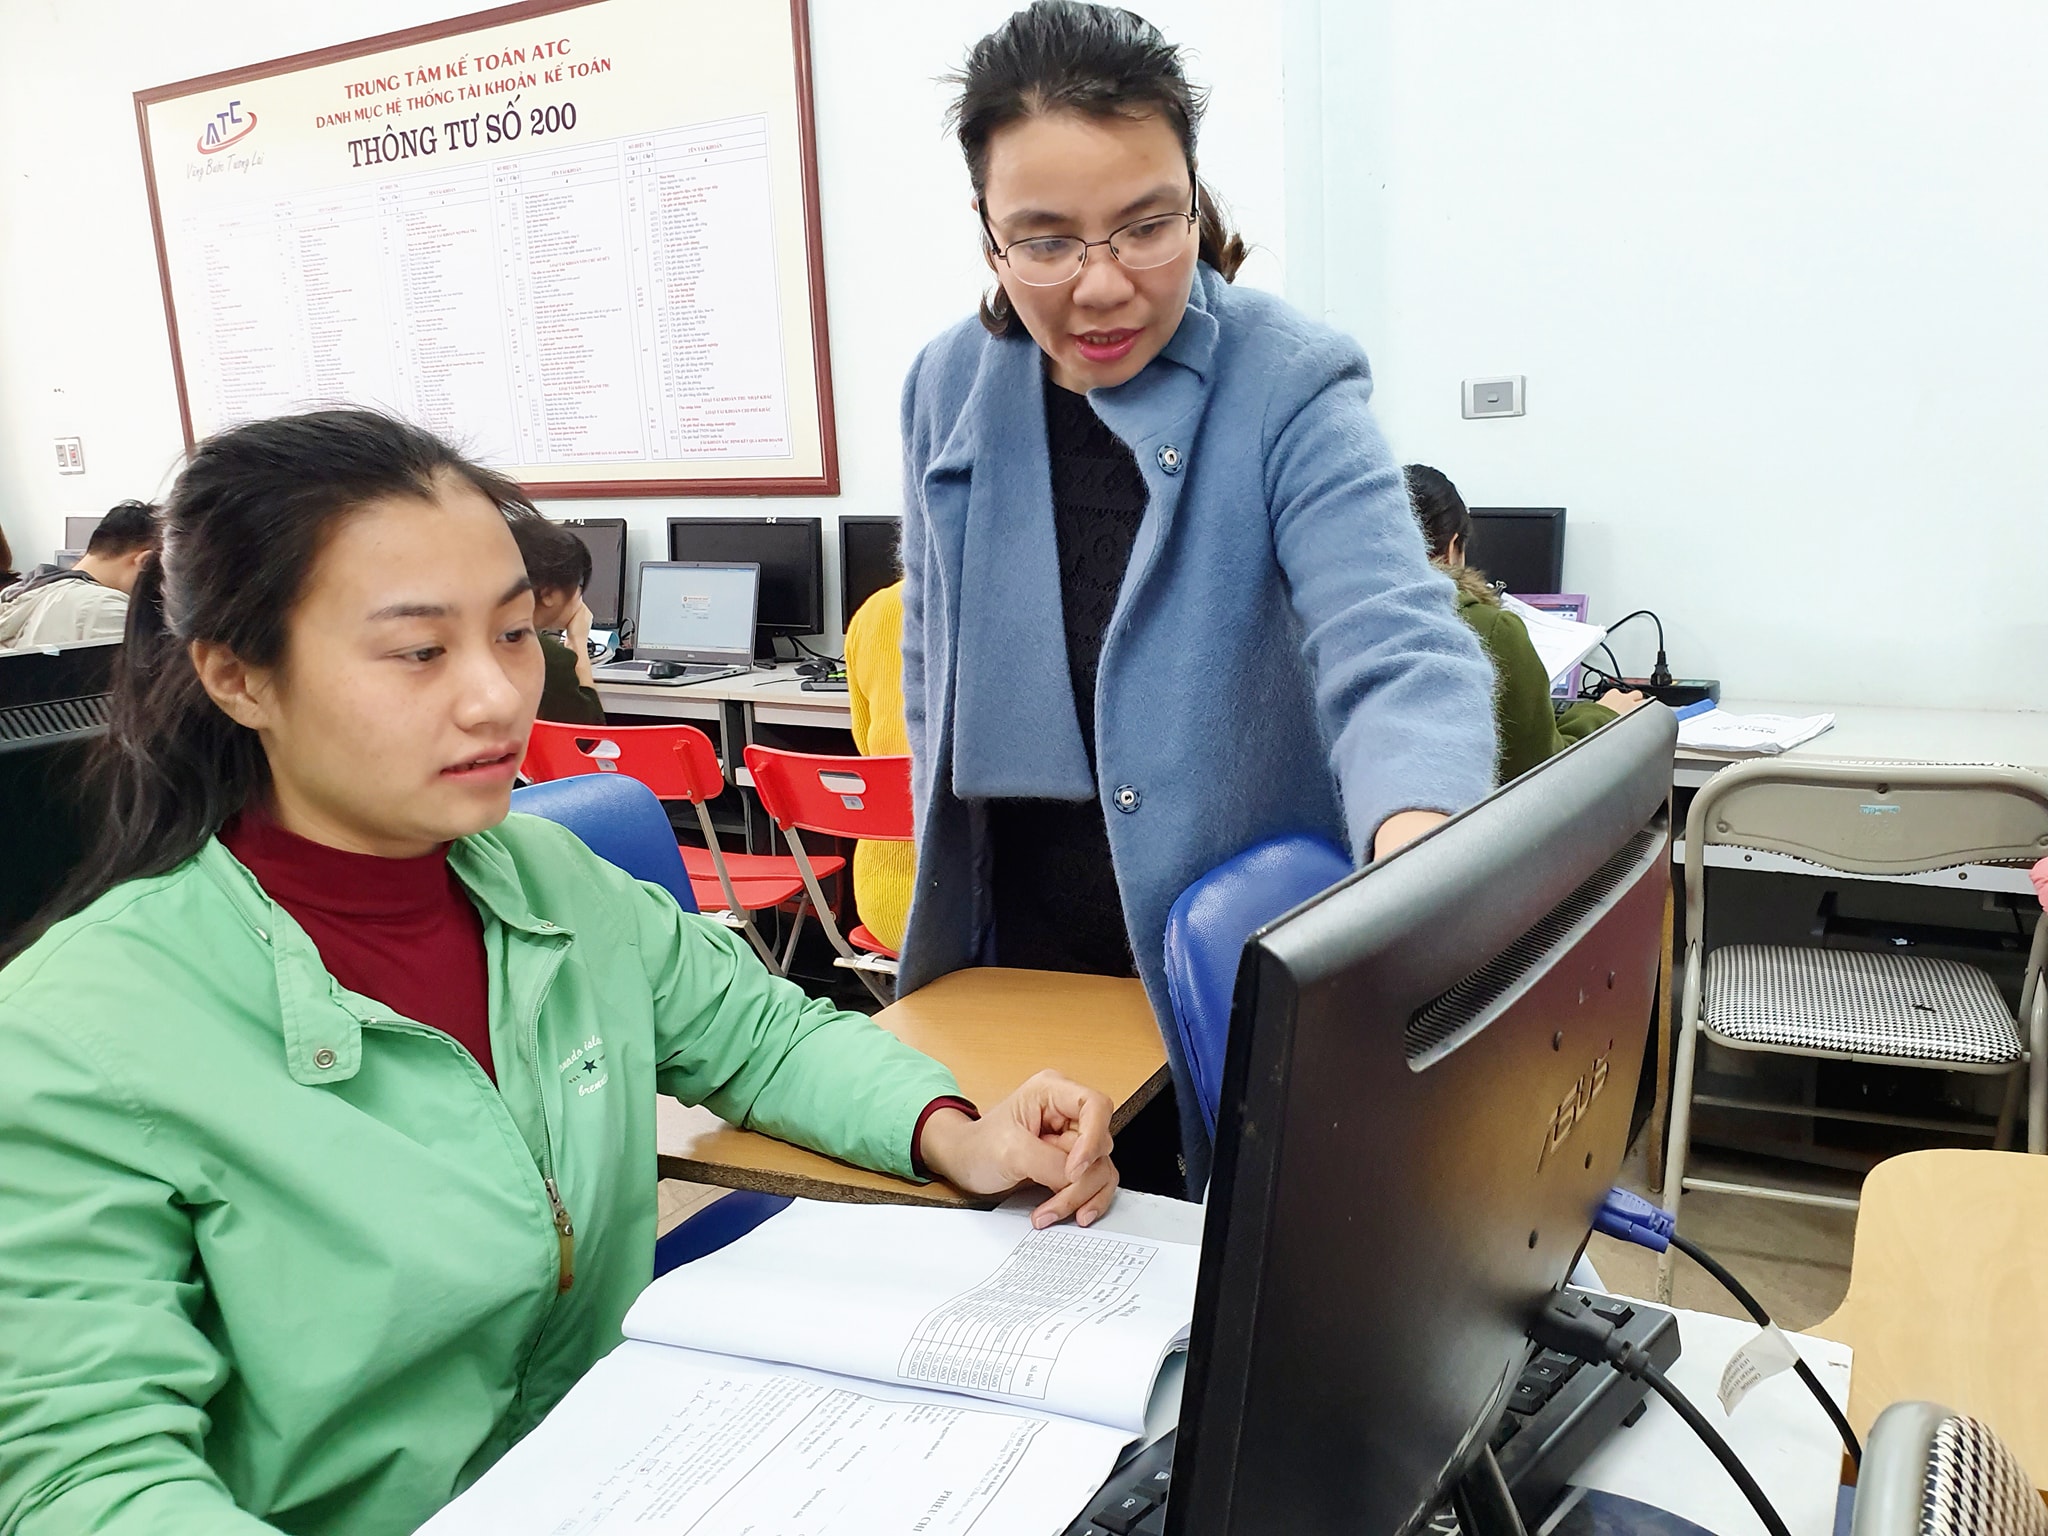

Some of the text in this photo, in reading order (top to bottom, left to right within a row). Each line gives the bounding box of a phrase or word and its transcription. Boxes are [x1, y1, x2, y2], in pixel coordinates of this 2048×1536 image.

[316, 57, 611, 129] DANH MỤC HỆ THỐNG TÀI KHOẢN KẾ TOÁN
[345, 39, 571, 99] TRUNG TÂM KẾ TOÁN ATC
[206, 101, 242, 145] ATC
[348, 94, 577, 168] THÔNG TƯ SỐ 200
[912, 1516, 931, 1532] CHI
